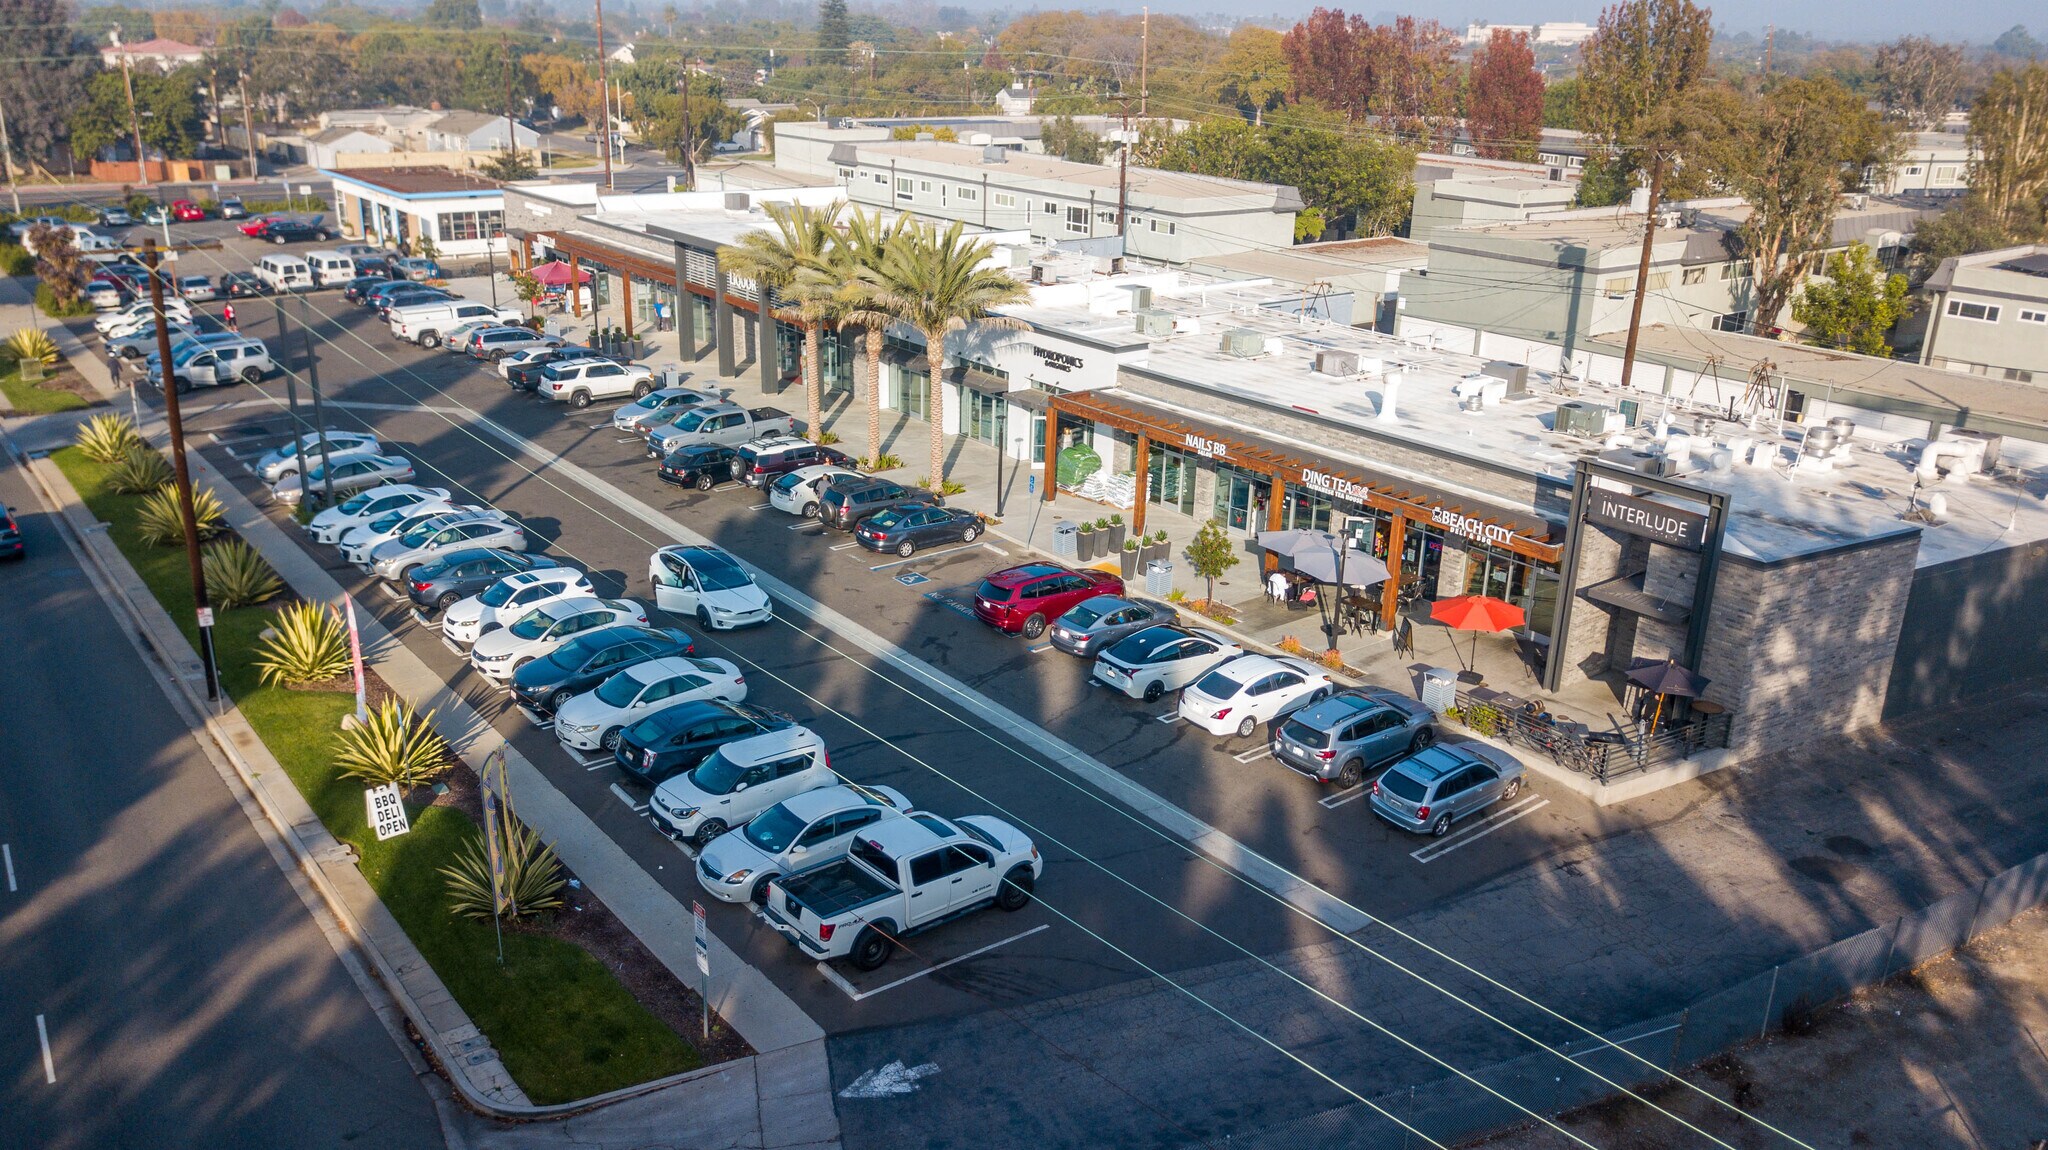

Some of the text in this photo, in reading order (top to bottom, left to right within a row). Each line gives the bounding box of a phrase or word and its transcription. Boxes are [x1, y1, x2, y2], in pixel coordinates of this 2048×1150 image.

[730, 269, 757, 292] LIQUOR
[1185, 434, 1226, 456] NAILS BB
[1302, 468, 1352, 494] DING TEA
[1305, 482, 1363, 504] TAIWANESE TEA HOUSE
[1441, 510, 1515, 545] BEACH CITY
[1601, 500, 1688, 538] INTERLUDE
[1449, 527, 1466, 538] DELI
[1476, 535, 1492, 546] BBQ
[374, 792, 397, 809] BBQ
[377, 805, 401, 822] DELI
[379, 818, 407, 836] OPEN
